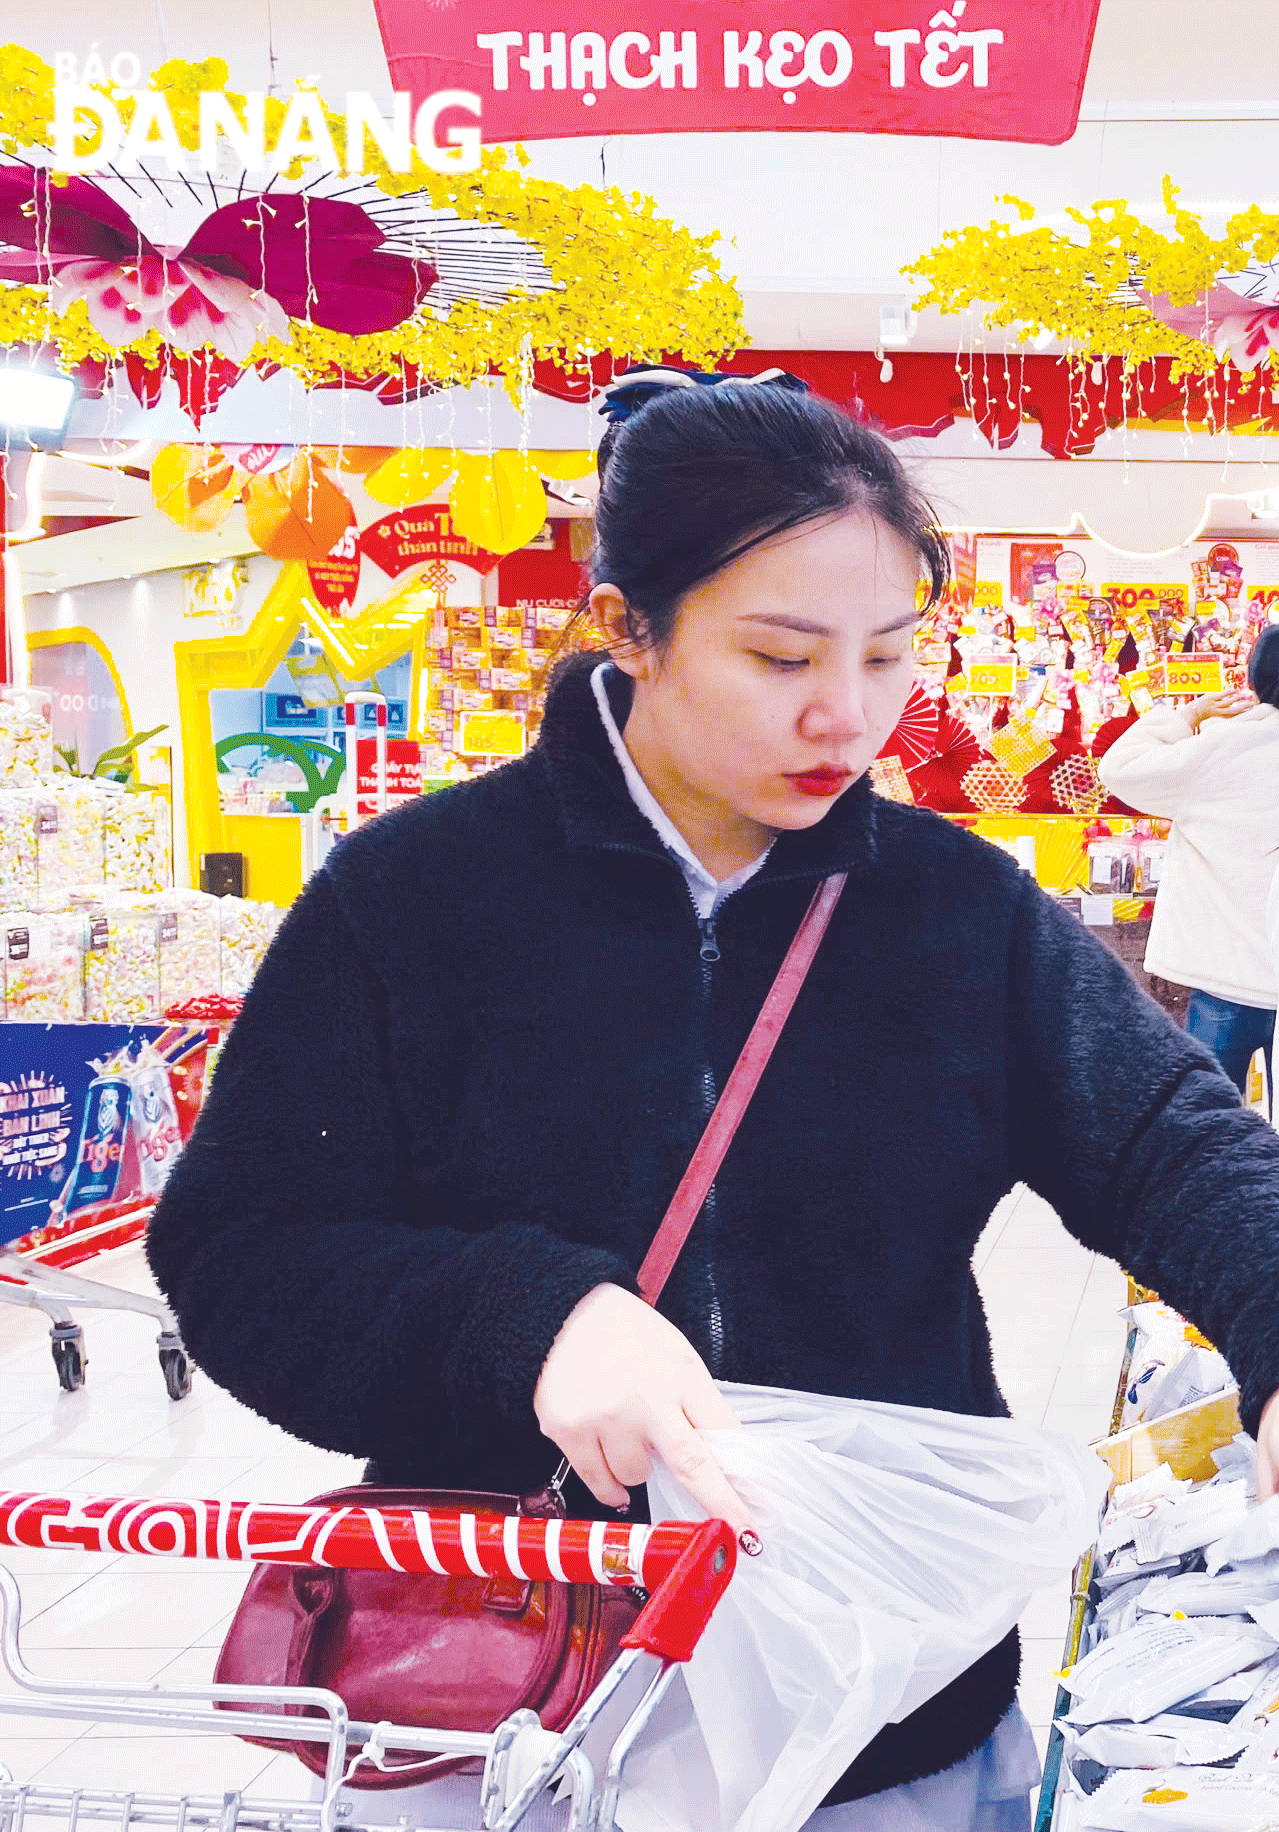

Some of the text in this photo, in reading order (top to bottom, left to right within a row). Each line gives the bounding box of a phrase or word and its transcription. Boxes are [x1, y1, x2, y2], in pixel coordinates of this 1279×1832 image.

[476, 0, 1004, 106] THẠCH KẸO TẾT
